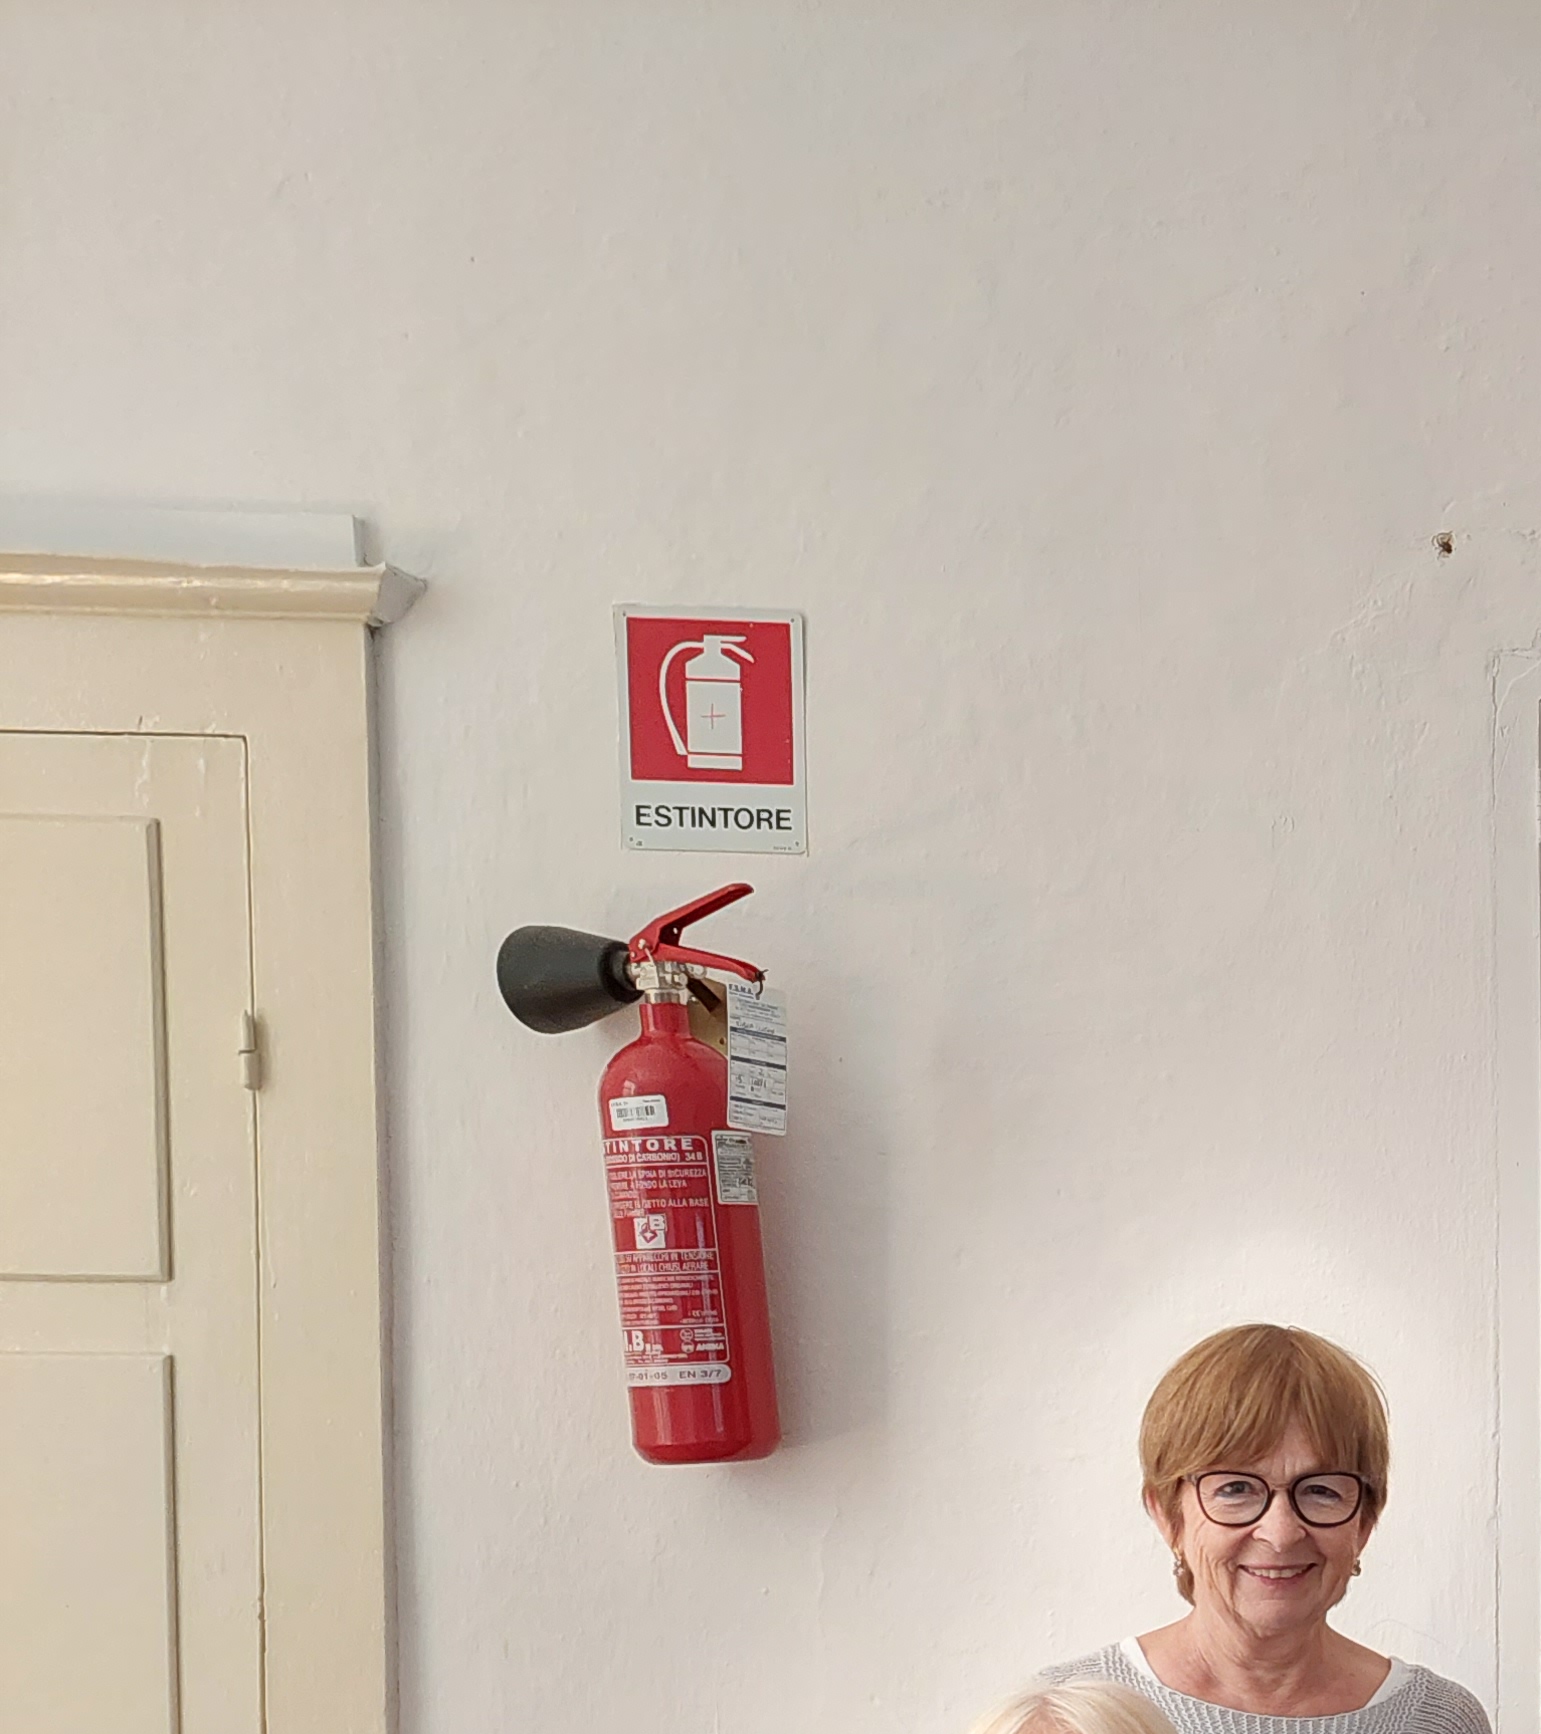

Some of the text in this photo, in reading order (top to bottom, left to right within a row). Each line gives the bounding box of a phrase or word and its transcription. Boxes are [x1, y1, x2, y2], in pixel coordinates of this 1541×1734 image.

[635, 804, 792, 831] ESTINTORE
[679, 1370, 696, 1379] EN
[700, 1369, 722, 1378] 3/7
